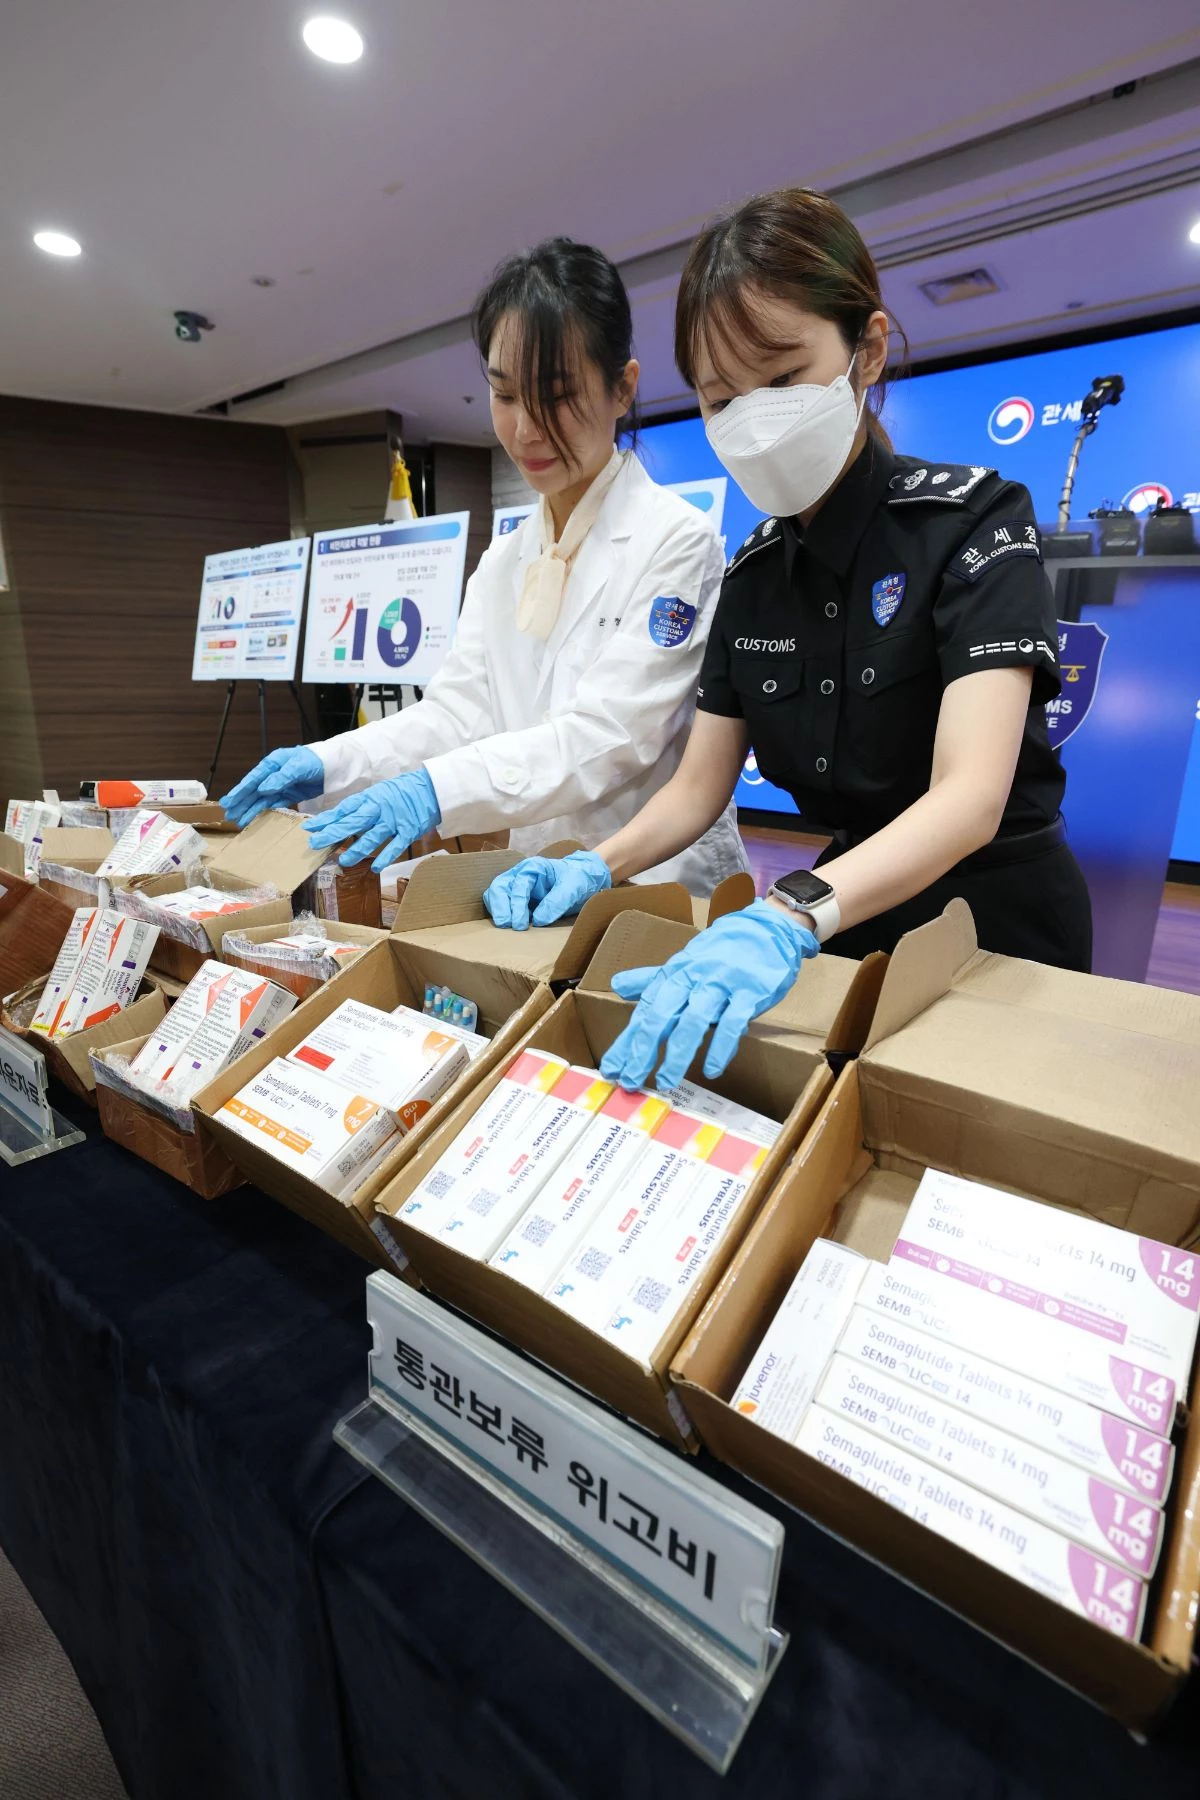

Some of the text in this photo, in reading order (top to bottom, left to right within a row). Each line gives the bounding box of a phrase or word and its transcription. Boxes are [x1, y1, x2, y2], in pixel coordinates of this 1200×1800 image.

[1041, 400, 1093, 426] 관세
[501, 520, 510, 533] 2
[968, 556, 991, 573] KOREA
[990, 542, 1022, 557] CUSTOMS
[876, 600, 899, 613] CUSTOMS
[878, 607, 896, 618] SERVICE
[880, 594, 897, 605] KOREA
[653, 624, 684, 636] CUSTOMS
[655, 631, 678, 640] SERVICE
[658, 618, 681, 630] KOREA
[735, 637, 796, 652] CUSTOMS
[344, 1005, 380, 1025] Semaglutide
[377, 1015, 403, 1031] Tablets
[263, 1073, 301, 1099] Semaglutide
[300, 1090, 321, 1110] Tablets
[325, 1105, 339, 1120] mg
[356, 1103, 374, 1117] 7
[346, 1115, 362, 1130] mg
[532, 1105, 569, 1147] RYBELSUS
[506, 1109, 578, 1194] Semaglutide Tablets
[586, 1124, 622, 1171] RYBELSUS
[562, 1129, 632, 1222] Semaglutide Tablets
[641, 1152, 677, 1201] RYBELSUS
[618, 1157, 688, 1254] Semaglutide Tablets
[699, 1178, 734, 1228] RYBELSUS
[678, 1183, 746, 1286] Semaglutide Tablets
[1089, 1251, 1137, 1283] 14 mg
[1161, 1249, 1195, 1281] 14
[1156, 1274, 1191, 1298] mg
[746, 1351, 778, 1404] juvenor
[868, 1323, 1064, 1426] Semaglutide Tablets 14 mg
[1132, 1366, 1170, 1401] 14
[955, 1388, 971, 1405] 14
[1126, 1393, 1165, 1421] mg
[848, 1374, 1050, 1490] Semaglutide Tablets 14 mg
[937, 1445, 954, 1463] 14
[1126, 1429, 1166, 1469] 14
[393, 1336, 717, 1602] 통관보류 위고비
[1120, 1459, 1159, 1489] mg
[823, 1425, 1029, 1556] Semaglutide Tablets 14 mg
[1113, 1493, 1154, 1538] 14
[1107, 1525, 1149, 1562] mg
[1094, 1562, 1136, 1613] 14
[1087, 1599, 1130, 1638] mg
